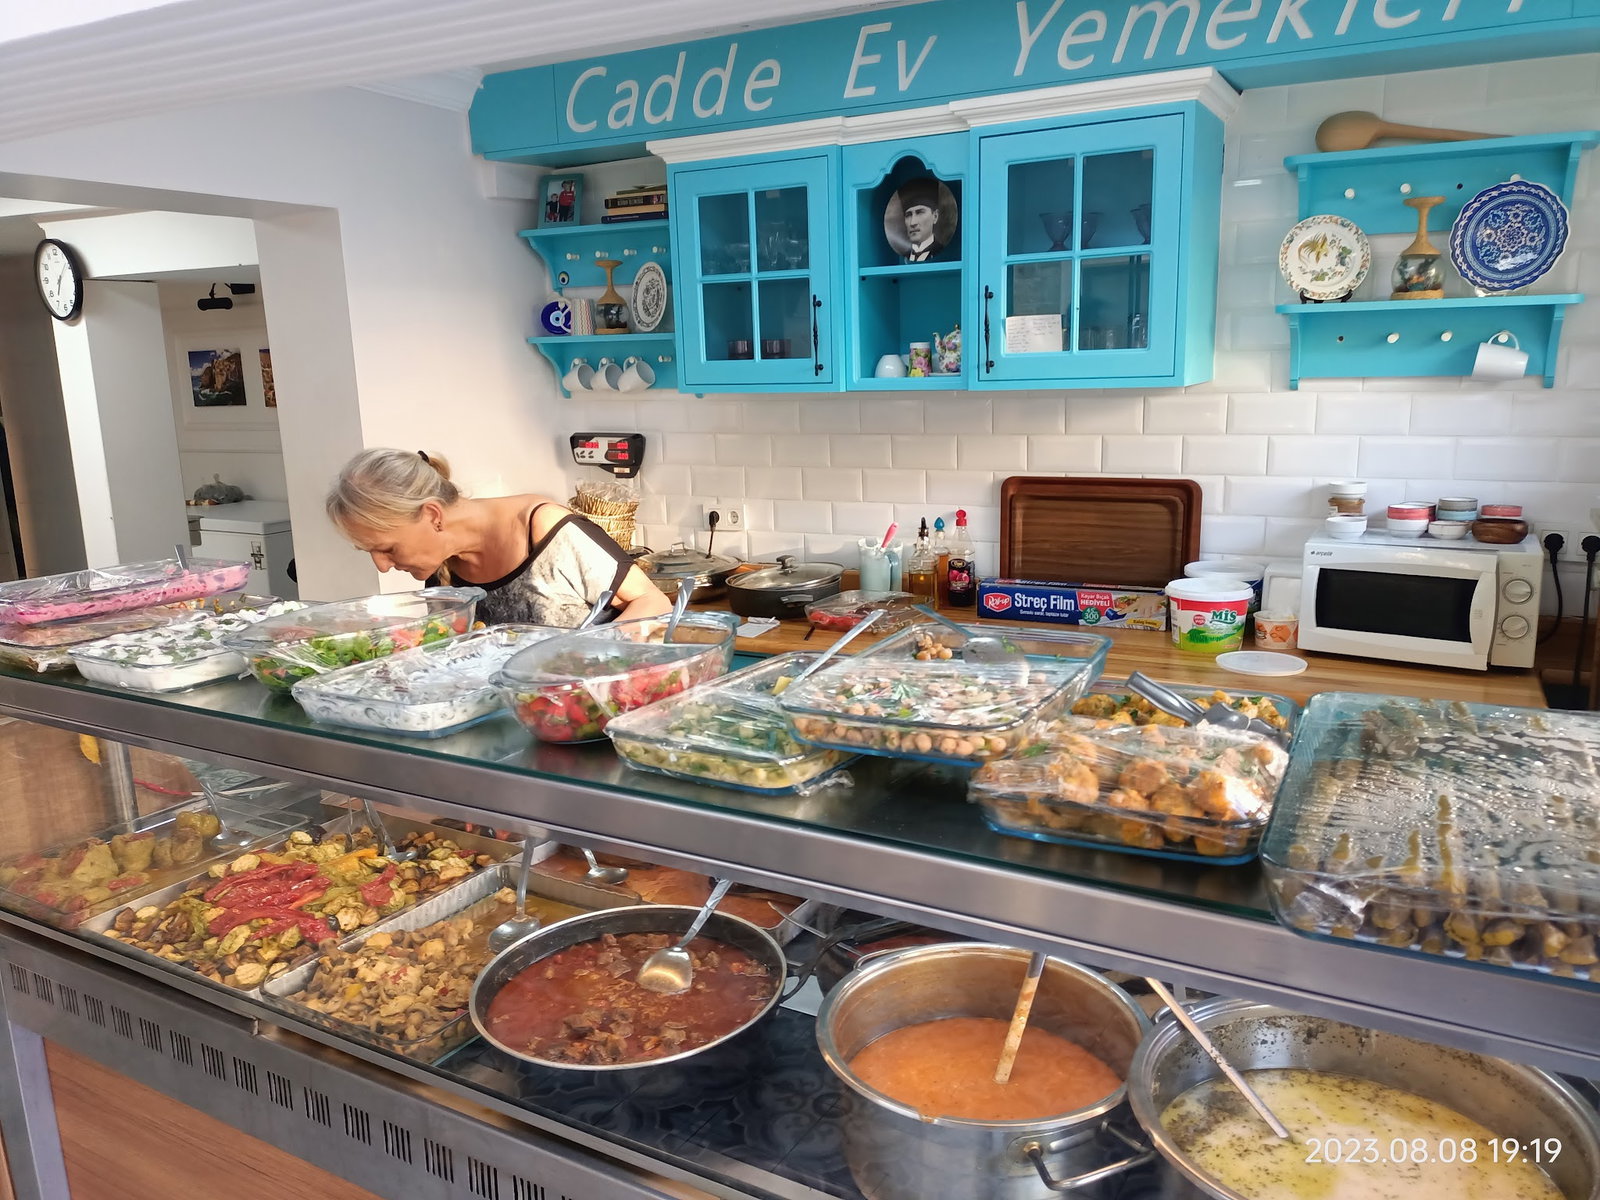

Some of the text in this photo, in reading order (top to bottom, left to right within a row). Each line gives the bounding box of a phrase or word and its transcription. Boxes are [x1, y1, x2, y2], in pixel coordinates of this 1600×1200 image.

[565, 0, 1523, 133] Cadde Ev Yemek
[1014, 592, 1075, 612] Streç Film
[1084, 612, 1099, 620] 300
